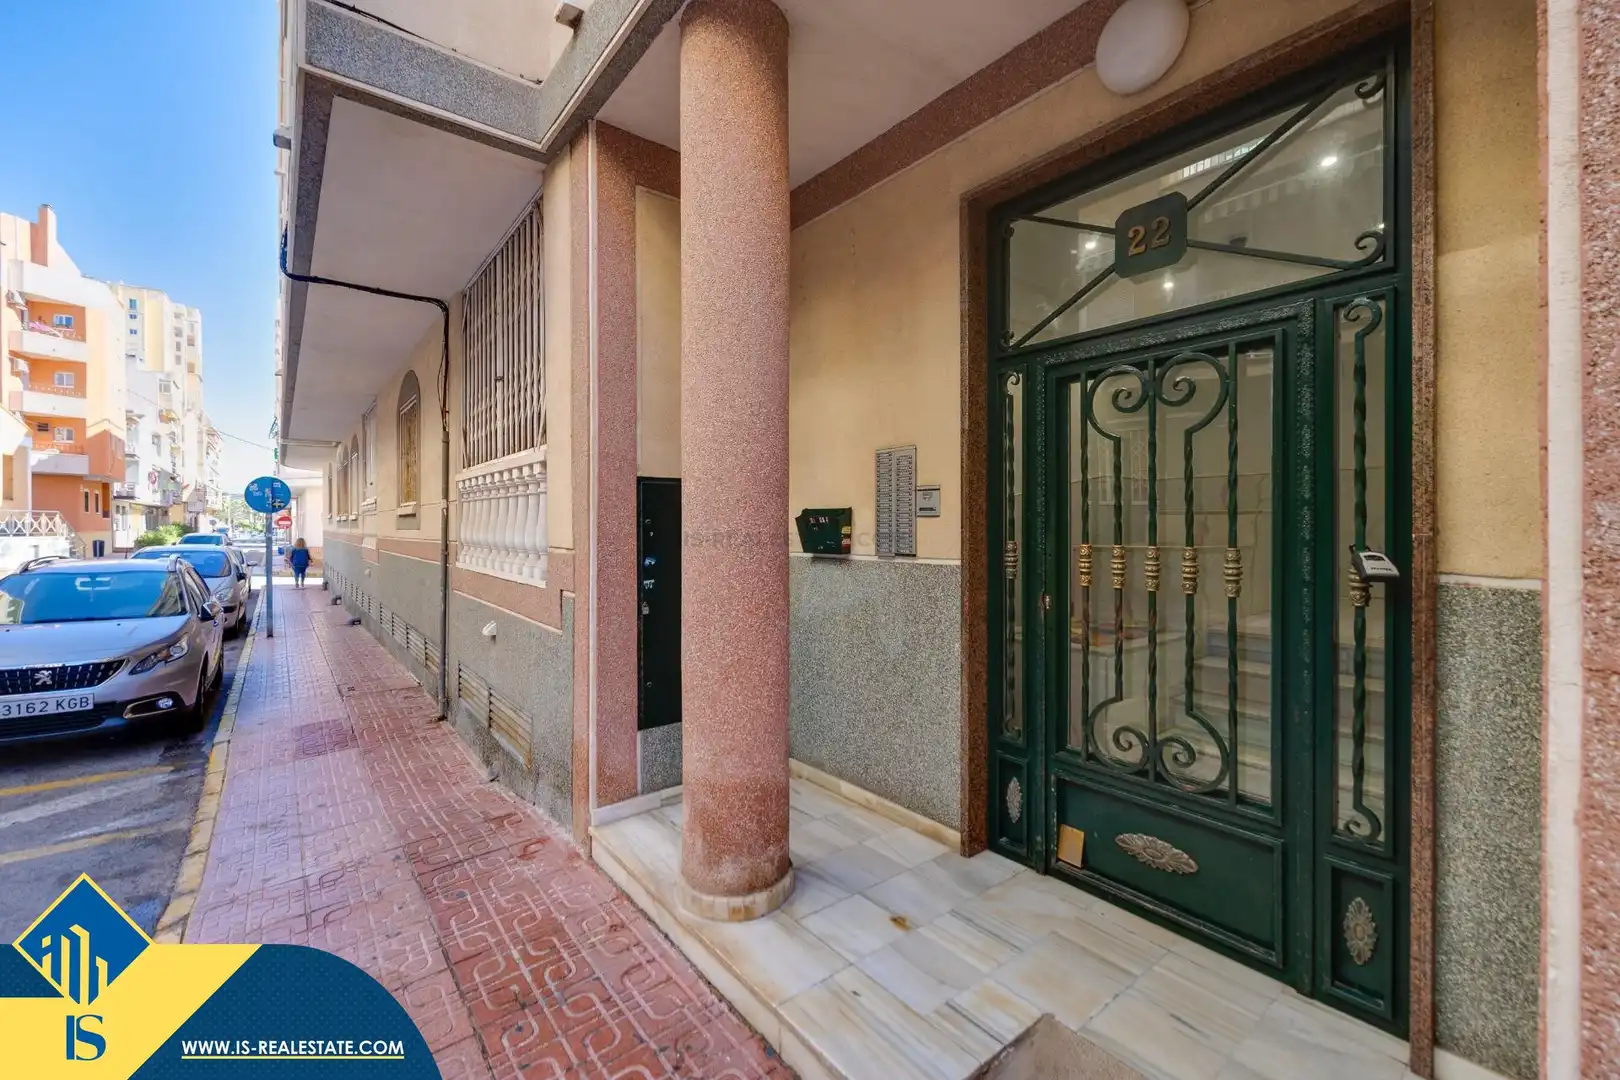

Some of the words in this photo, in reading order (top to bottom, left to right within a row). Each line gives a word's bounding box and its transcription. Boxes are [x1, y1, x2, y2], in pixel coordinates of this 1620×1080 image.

[1127, 216, 1170, 257] 22
[2, 701, 48, 716] 3162
[56, 696, 89, 711] KGB
